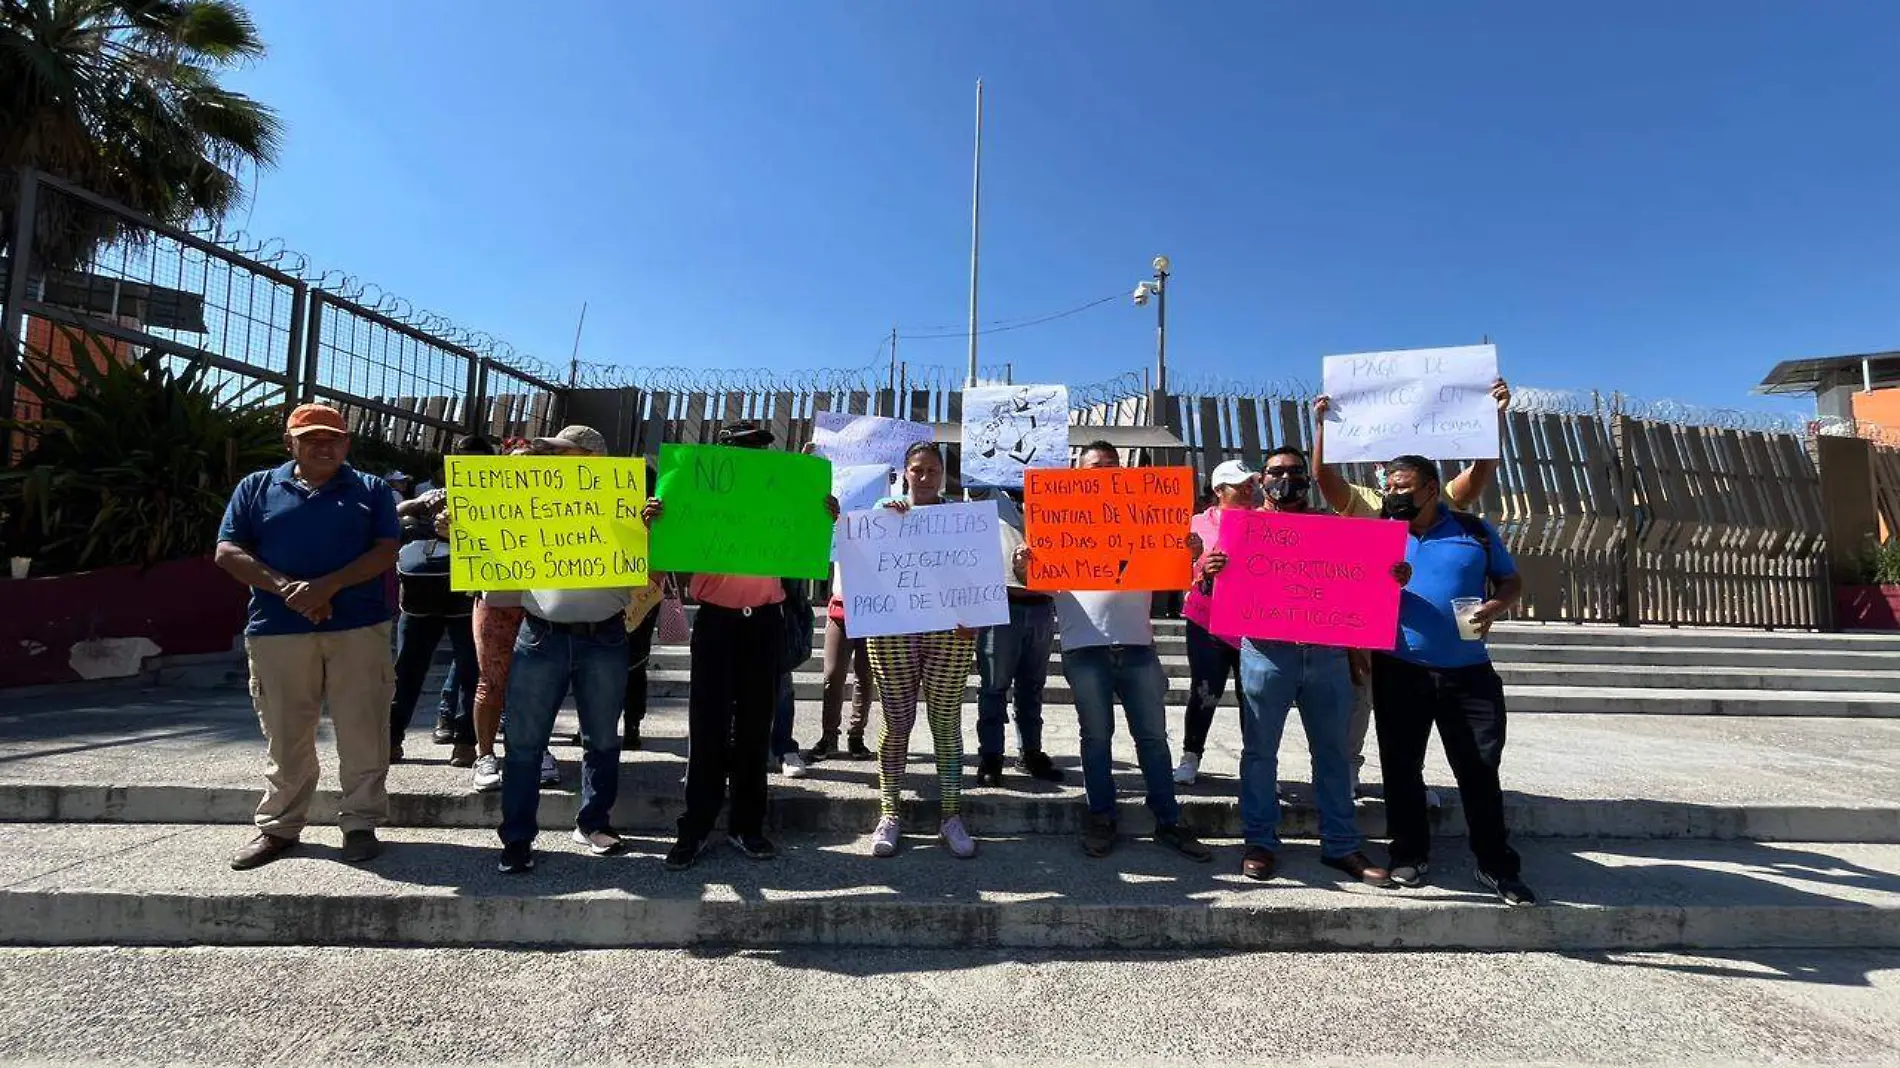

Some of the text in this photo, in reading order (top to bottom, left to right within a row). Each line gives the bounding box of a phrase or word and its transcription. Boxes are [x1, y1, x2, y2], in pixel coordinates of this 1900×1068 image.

[1345, 357, 1399, 380] PAGO
[451, 461, 638, 491] ELEMENTOS DE LA
[694, 456, 735, 494] NO
[1031, 472, 1180, 495] EXIGIMOS EL PAGO
[453, 496, 636, 521] POLICIA ESTATAL EN
[1030, 503, 1095, 525] PUNTUAL
[1102, 503, 1121, 524] DE
[455, 526, 607, 552] PIE DE LUCHA.
[847, 512, 988, 541] LAS FAMILIAS
[1243, 515, 1300, 546] PAGO
[1030, 533, 1053, 549] LOS
[1060, 532, 1097, 550] DIAS
[1108, 534, 1122, 548] 01
[1140, 535, 1156, 549] 16
[1163, 533, 1184, 549] DE
[458, 549, 646, 582] TODOS SOMOS UNO
[878, 549, 979, 572] EXIGIMOS
[1030, 555, 1129, 584] CADA MES!
[1246, 554, 1366, 581] OPORTUNO
[897, 571, 925, 589] EL
[854, 594, 896, 617] PAGO
[909, 592, 932, 610] DE
[1241, 604, 1366, 628] VIATICOS
